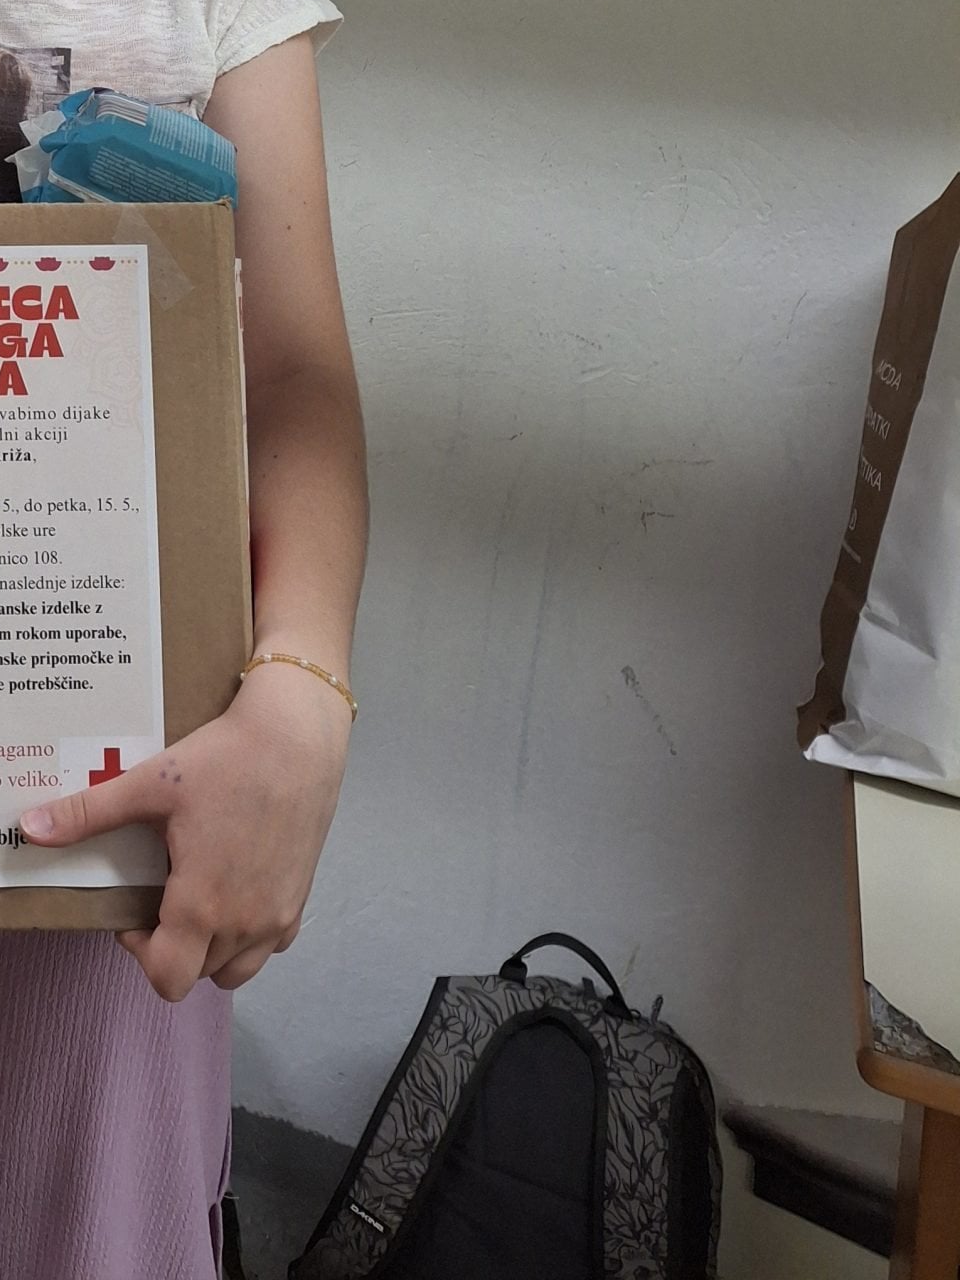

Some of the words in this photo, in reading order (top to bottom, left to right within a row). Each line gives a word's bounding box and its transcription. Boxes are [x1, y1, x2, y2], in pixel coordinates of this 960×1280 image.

[0, 407, 56, 420] vabimo
[63, 406, 110, 423] dijake
[25, 427, 67, 444] akciji
[1, 499, 20, 516] 5.,
[24, 499, 42, 512] do
[47, 498, 91, 515] petka,
[98, 498, 117, 511] 15.
[122, 498, 140, 515] 5.,
[33, 527, 55, 536] ure
[34, 550, 62, 565] 108.
[0, 576, 66, 593] naslednje
[72, 575, 124, 589] izdelke:
[42, 601, 90, 614] izdelke
[96, 605, 102, 613] z
[16, 627, 60, 640] rokom
[66, 626, 127, 644] uporabe,
[31, 651, 113, 668] pripomočke
[118, 651, 131, 663] in
[9, 676, 93, 694] potrebščine.
